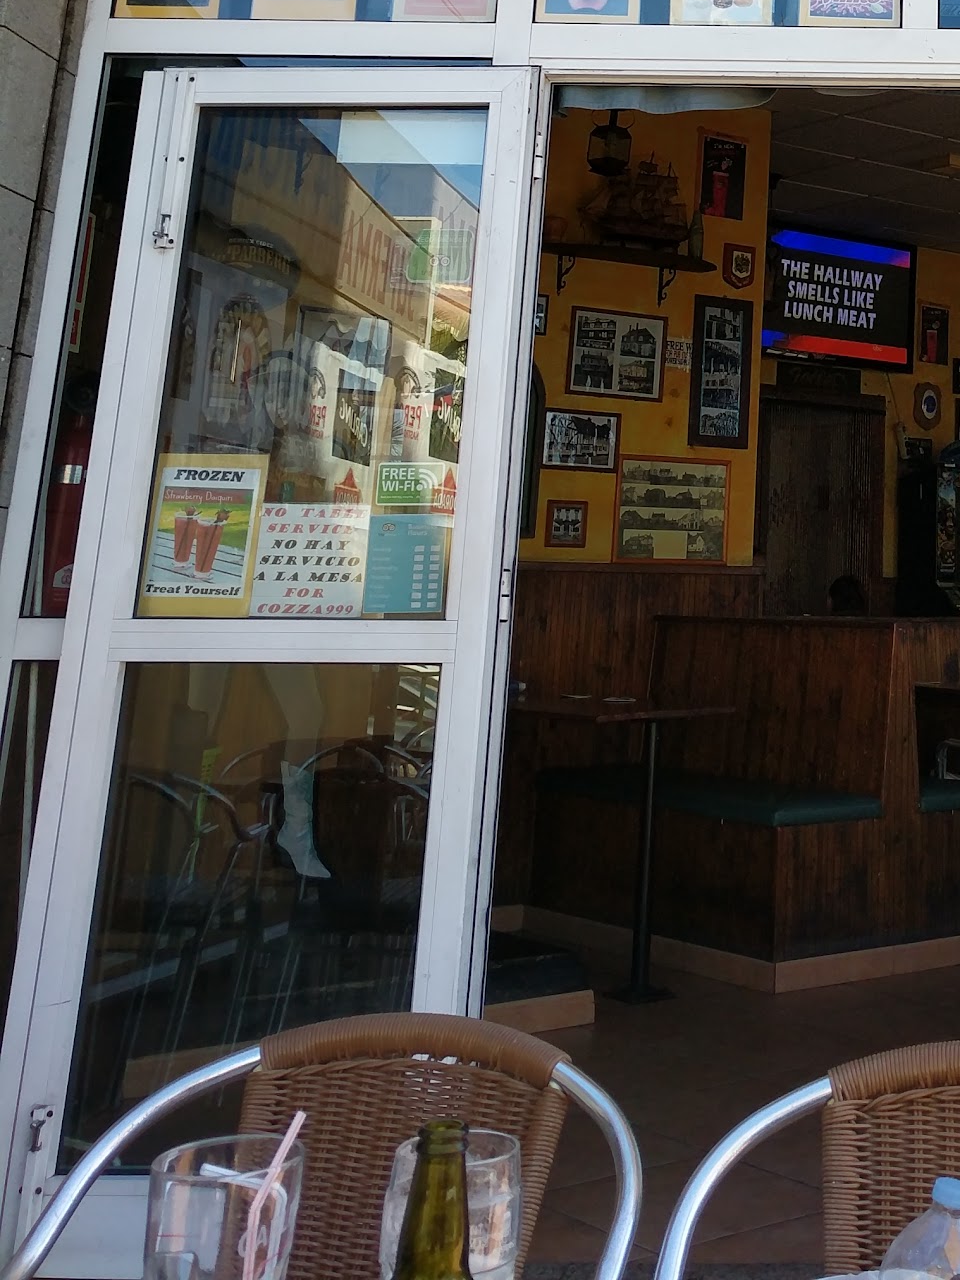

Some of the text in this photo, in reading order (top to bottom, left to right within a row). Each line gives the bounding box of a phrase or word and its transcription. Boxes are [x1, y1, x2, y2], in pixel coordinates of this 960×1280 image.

[781, 258, 884, 292] THE HALLWAY
[787, 280, 875, 310] SMELLS LIKE
[783, 300, 877, 330] LUNCH MEAT
[173, 469, 246, 483] FROZEN
[382, 467, 416, 480] FREE
[382, 480, 415, 492] WI-FI
[164, 488, 203, 505] Strawberry
[262, 507, 287, 518] NO
[266, 523, 354, 535] SERVICE
[271, 539, 351, 551] NO HAY
[259, 555, 361, 567] SERVICIO
[253, 571, 363, 583] A LA MESA
[145, 583, 242, 596] Treat Yourself
[282, 587, 325, 599] FOR
[257, 603, 354, 615] COZZA999
